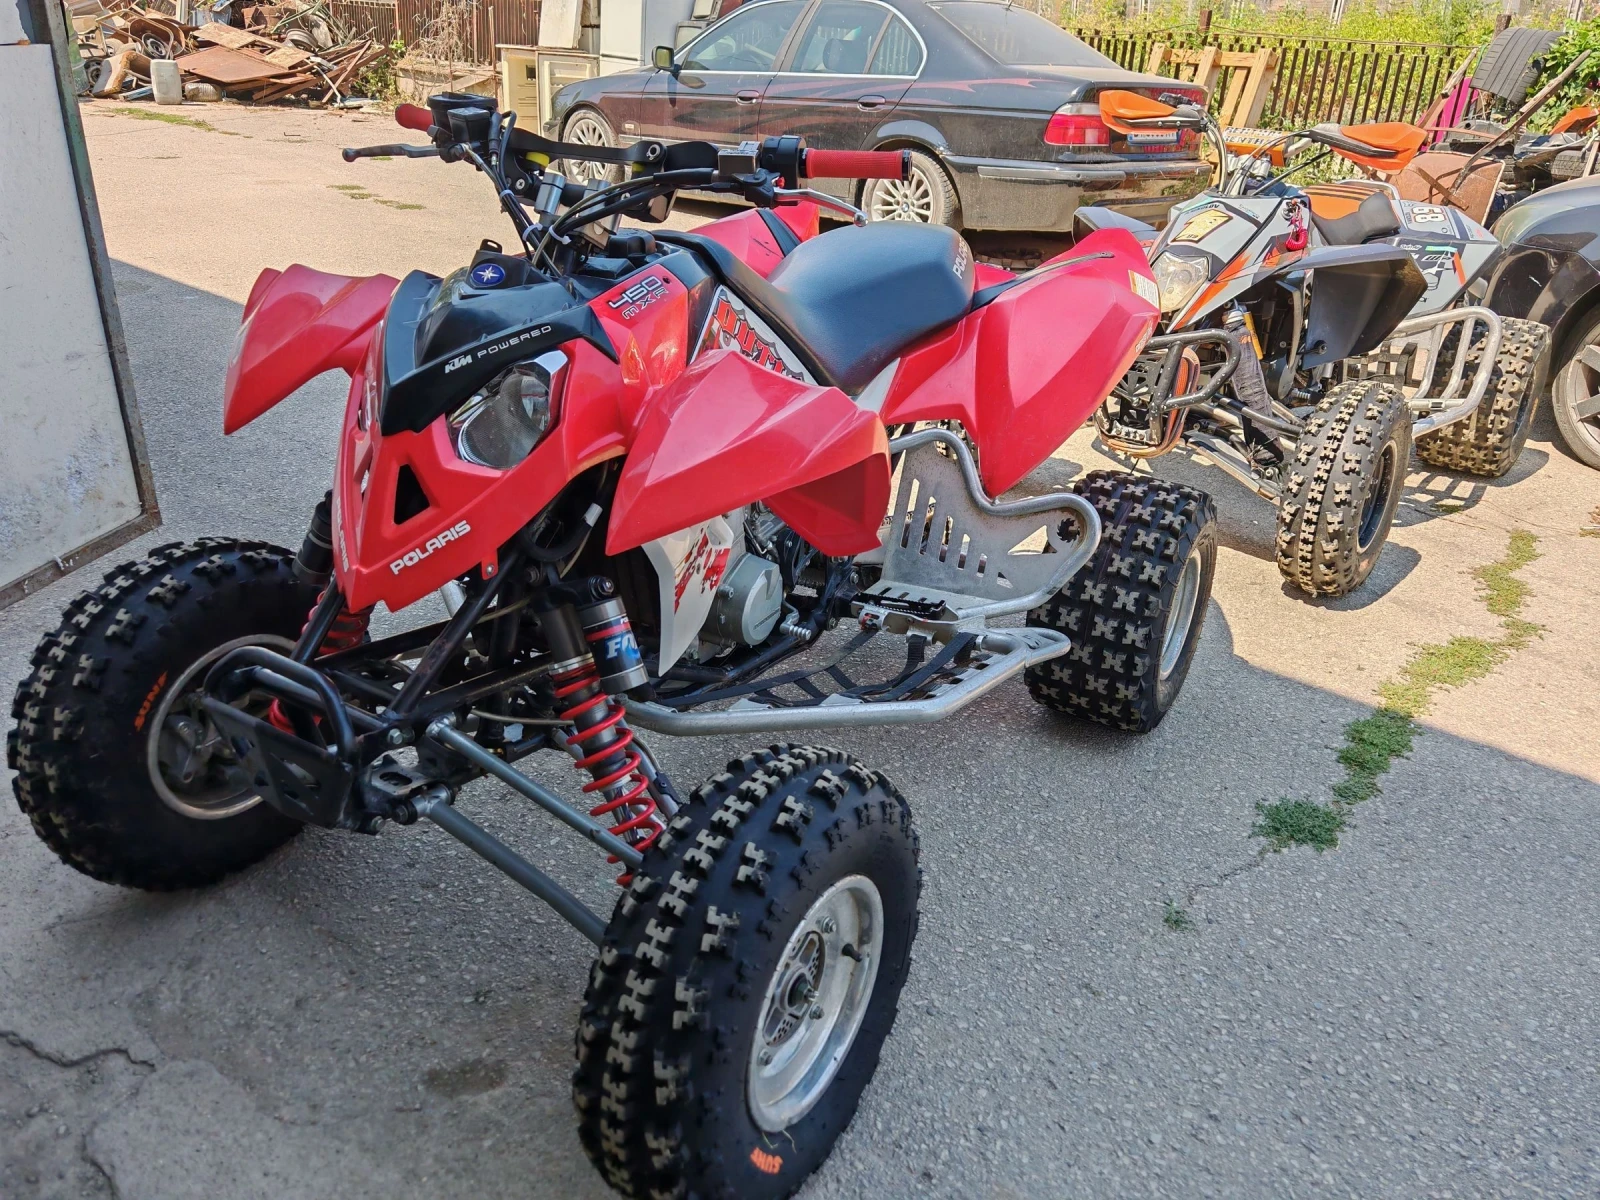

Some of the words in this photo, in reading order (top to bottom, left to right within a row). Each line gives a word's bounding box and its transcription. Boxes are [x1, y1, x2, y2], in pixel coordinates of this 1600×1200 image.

[608, 275, 663, 308] 450
[622, 286, 669, 320] MXR
[444, 354, 473, 374] KTM
[477, 325, 552, 358] POWERED
[389, 519, 472, 575] POLARIS
